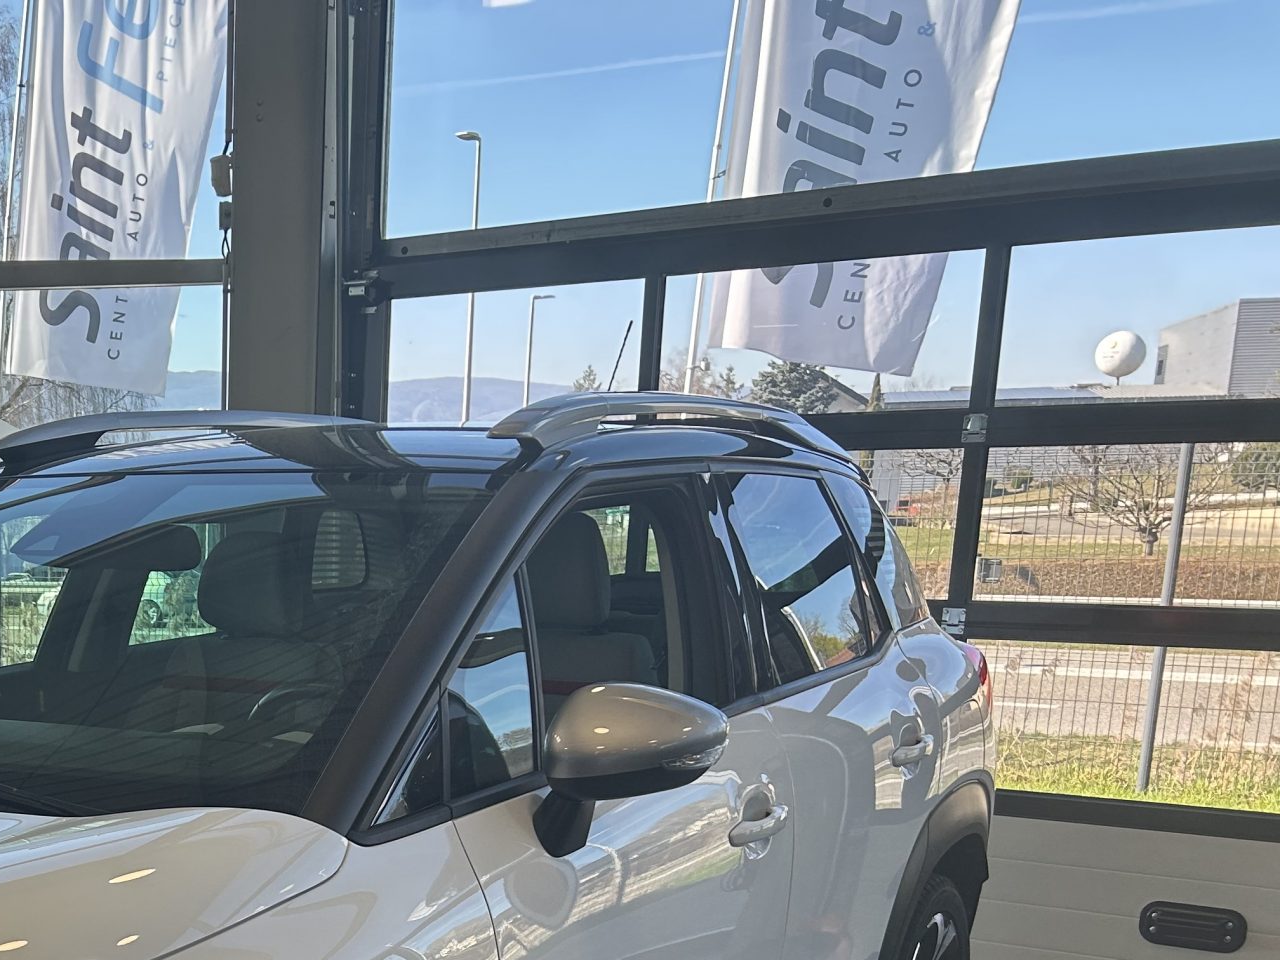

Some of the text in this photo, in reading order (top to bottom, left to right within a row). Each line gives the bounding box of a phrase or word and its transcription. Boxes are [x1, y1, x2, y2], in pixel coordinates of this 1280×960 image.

[883, 68, 923, 163] AUTO
[917, 19, 937, 38] &
[126, 172, 149, 242] AUTO
[144, 141, 155, 151] &
